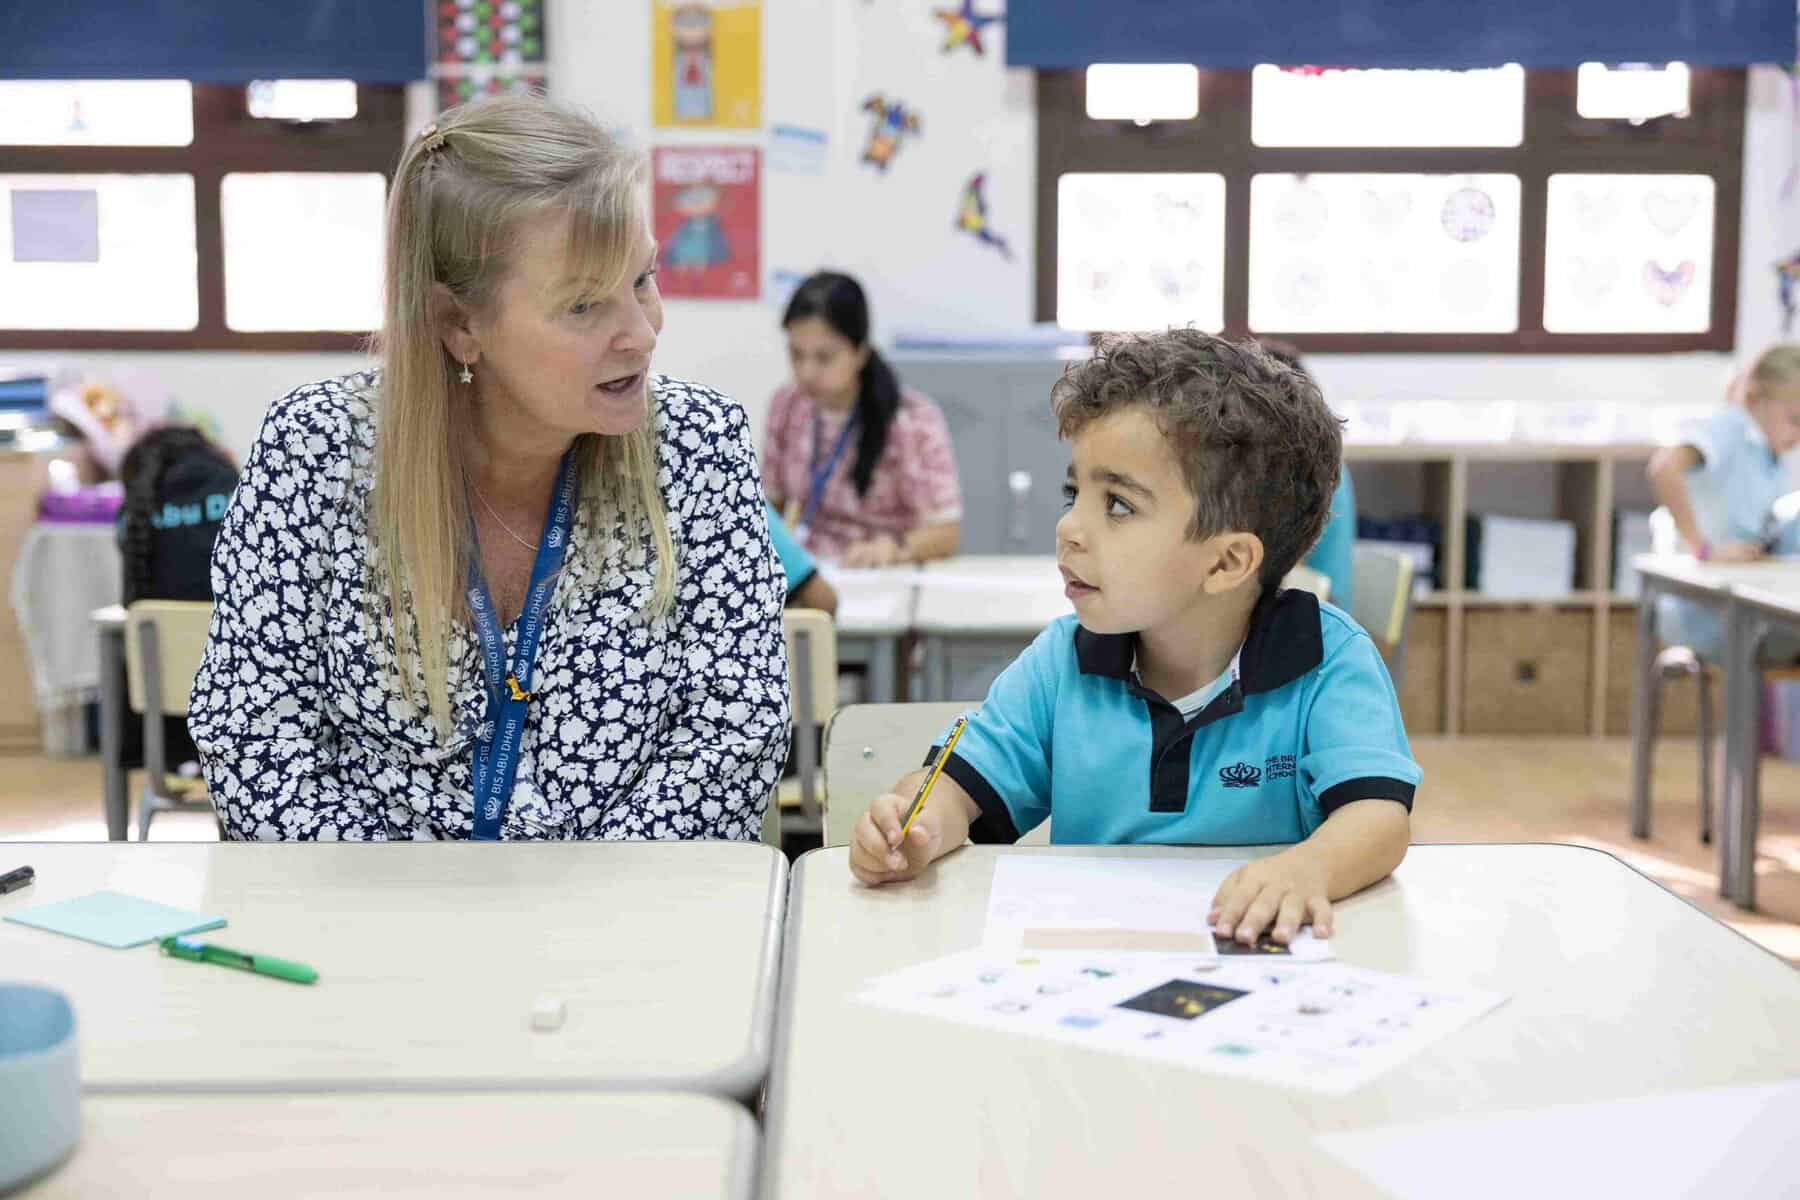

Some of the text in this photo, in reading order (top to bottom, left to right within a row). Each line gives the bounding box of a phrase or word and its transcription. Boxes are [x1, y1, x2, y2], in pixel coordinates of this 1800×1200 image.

[521, 583, 546, 656] BIS ABU DHABI
[480, 746, 490, 762] BIS
[491, 720, 517, 794] BIS ABU DHABI
